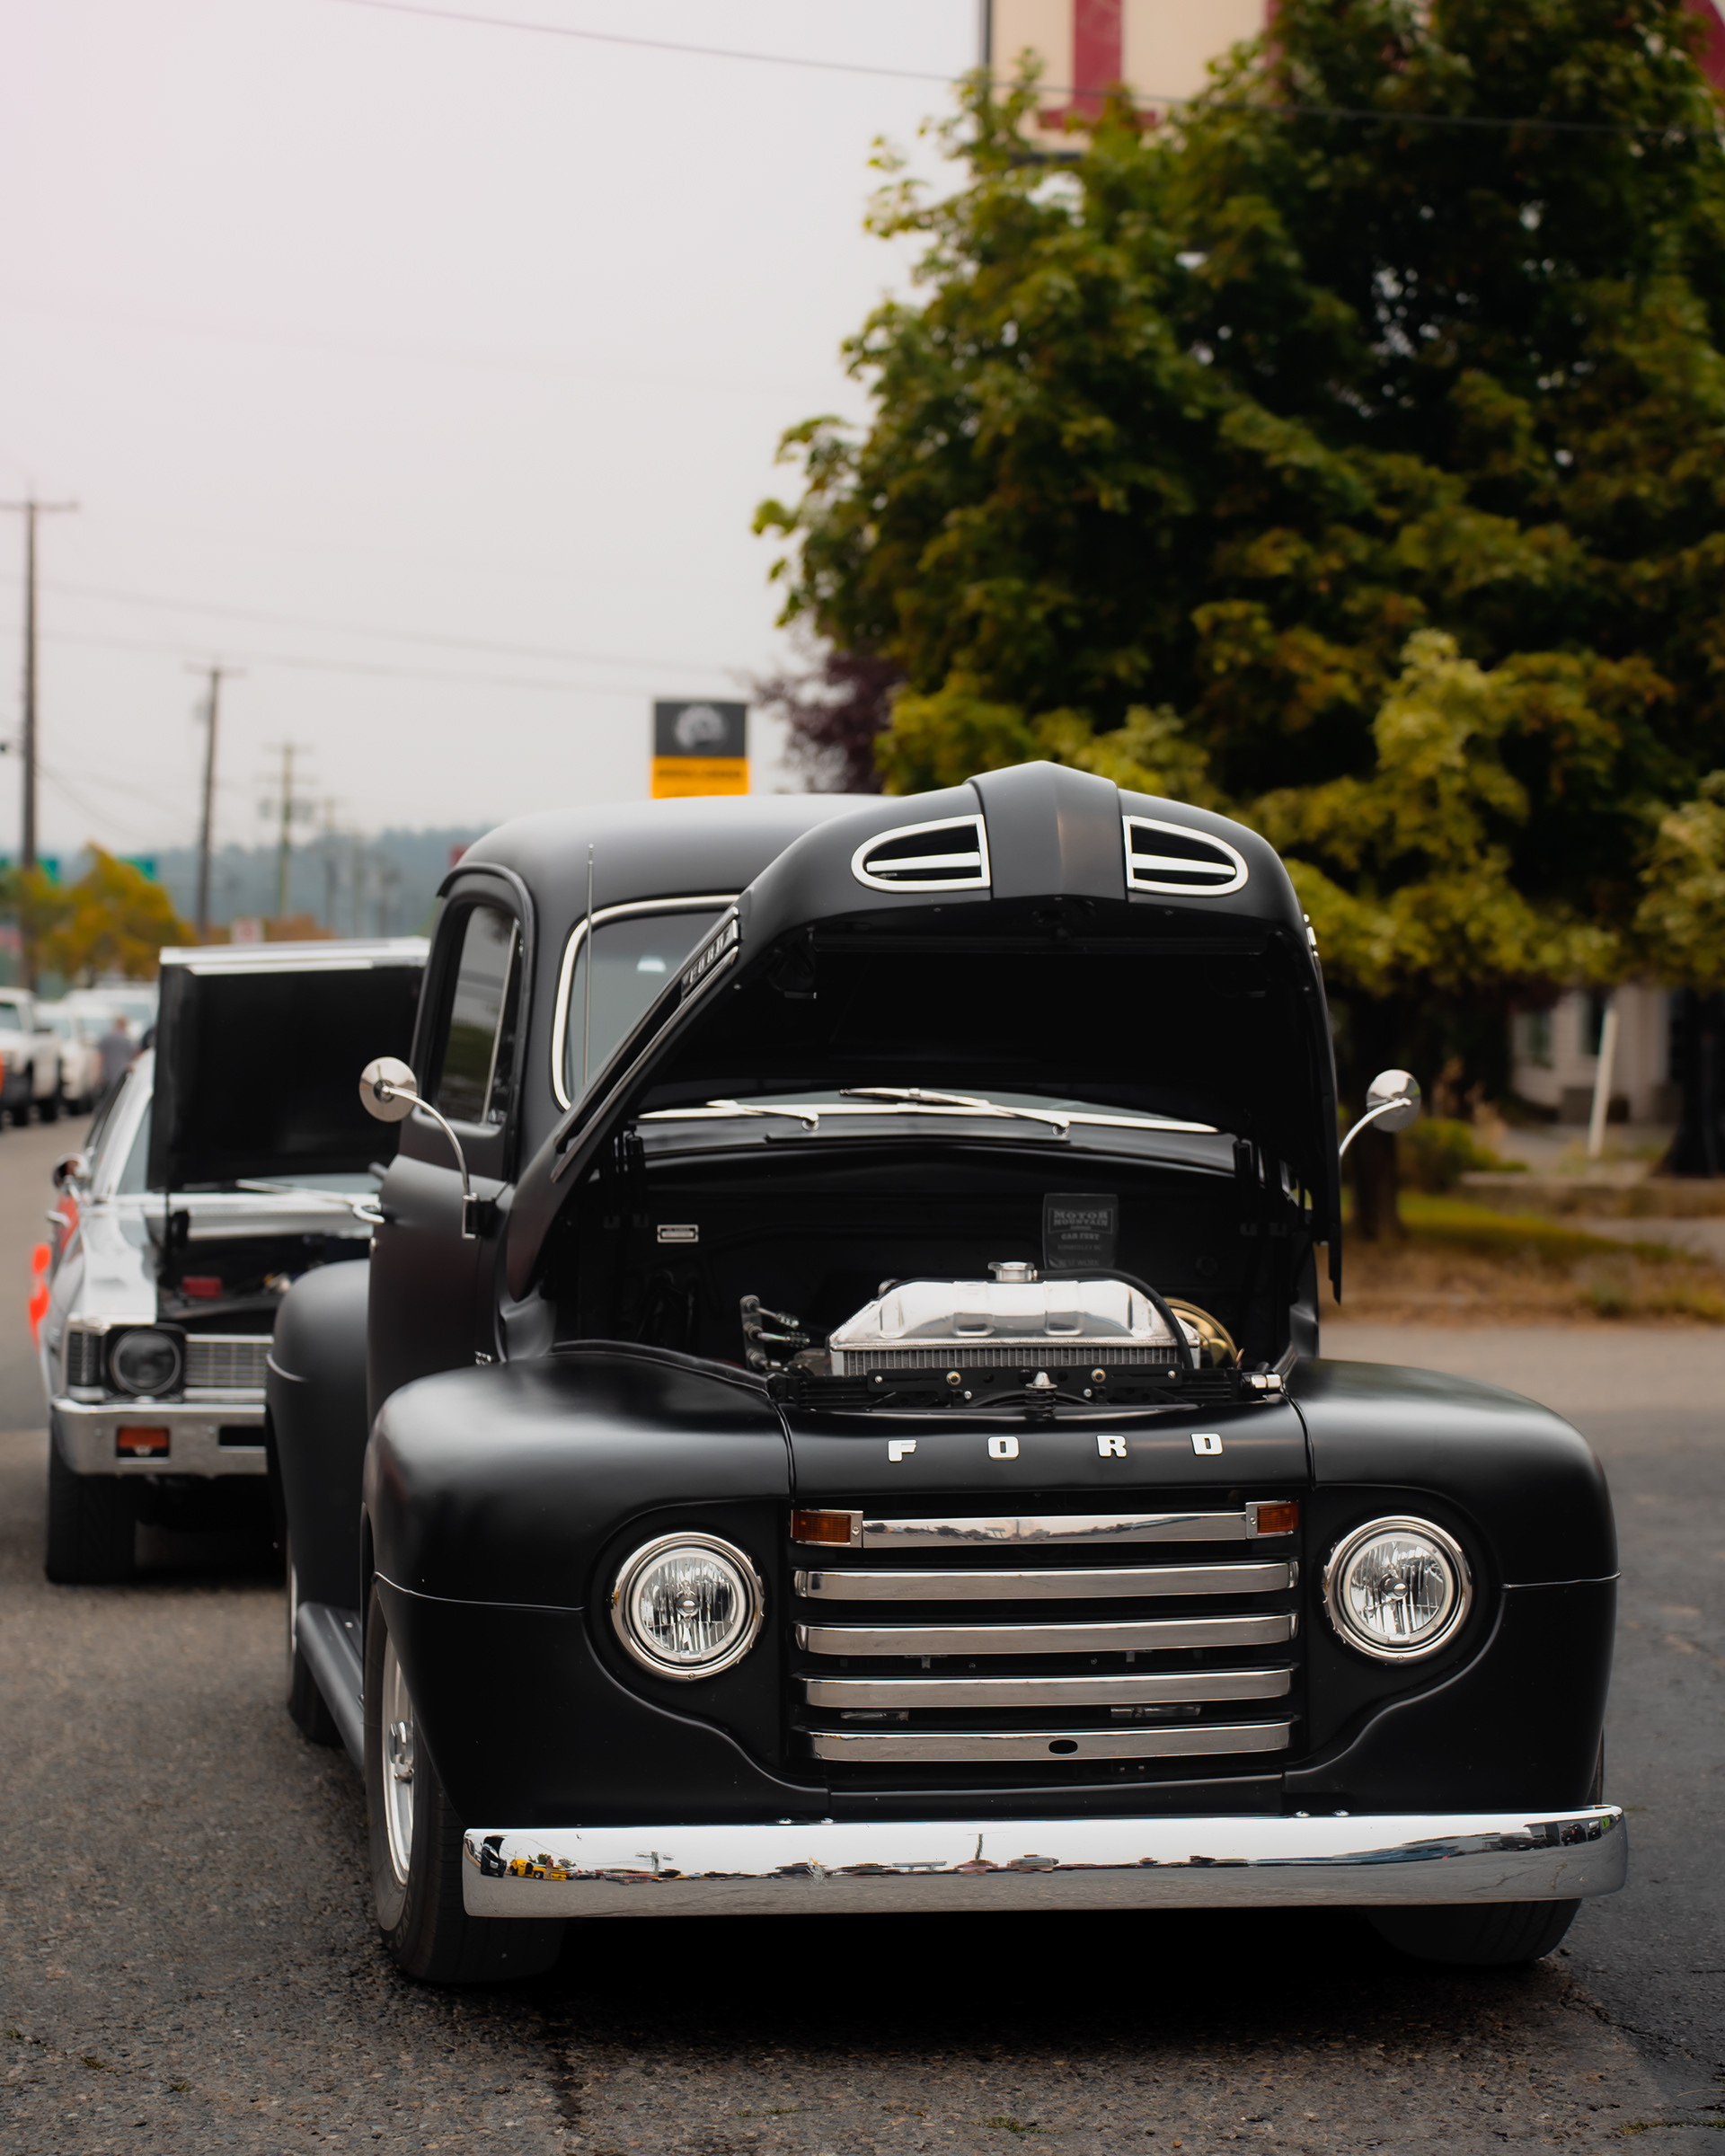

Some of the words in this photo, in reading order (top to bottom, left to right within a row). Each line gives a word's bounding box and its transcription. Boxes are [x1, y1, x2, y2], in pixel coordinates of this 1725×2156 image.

[1054, 1210, 1108, 1219] MOTOR
[1053, 1218, 1108, 1226] MOUNTAIN
[1061, 1233, 1078, 1241] CAR
[1079, 1233, 1100, 1241] FEST
[888, 1433, 1224, 1462] FORD
